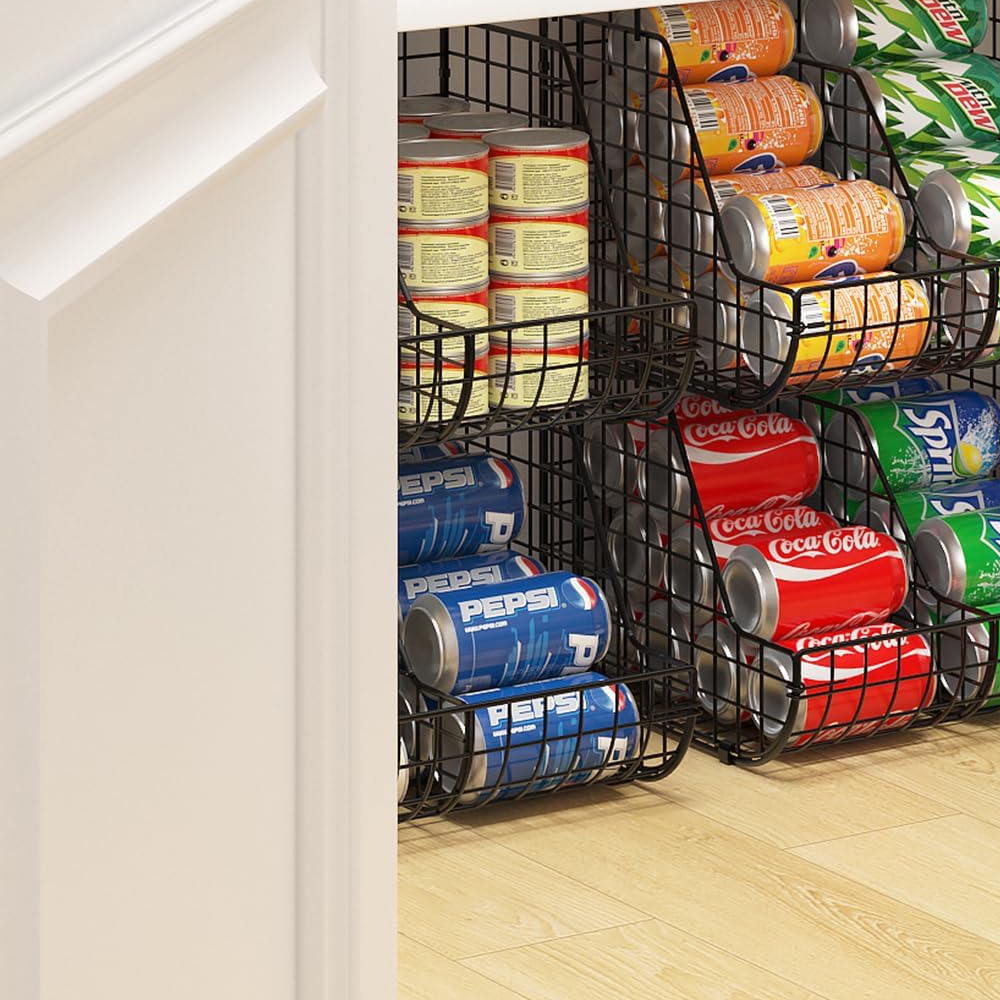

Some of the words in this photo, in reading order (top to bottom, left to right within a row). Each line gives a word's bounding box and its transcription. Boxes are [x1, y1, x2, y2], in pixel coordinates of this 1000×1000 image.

[684, 412, 795, 447] Coca-Cola
[710, 506, 821, 541] Coca-Cola
[768, 528, 880, 563] Coca-Cola
[403, 564, 501, 599] PEPSI
[458, 587, 559, 623] PEPSI
[487, 690, 588, 727] PEPSI
